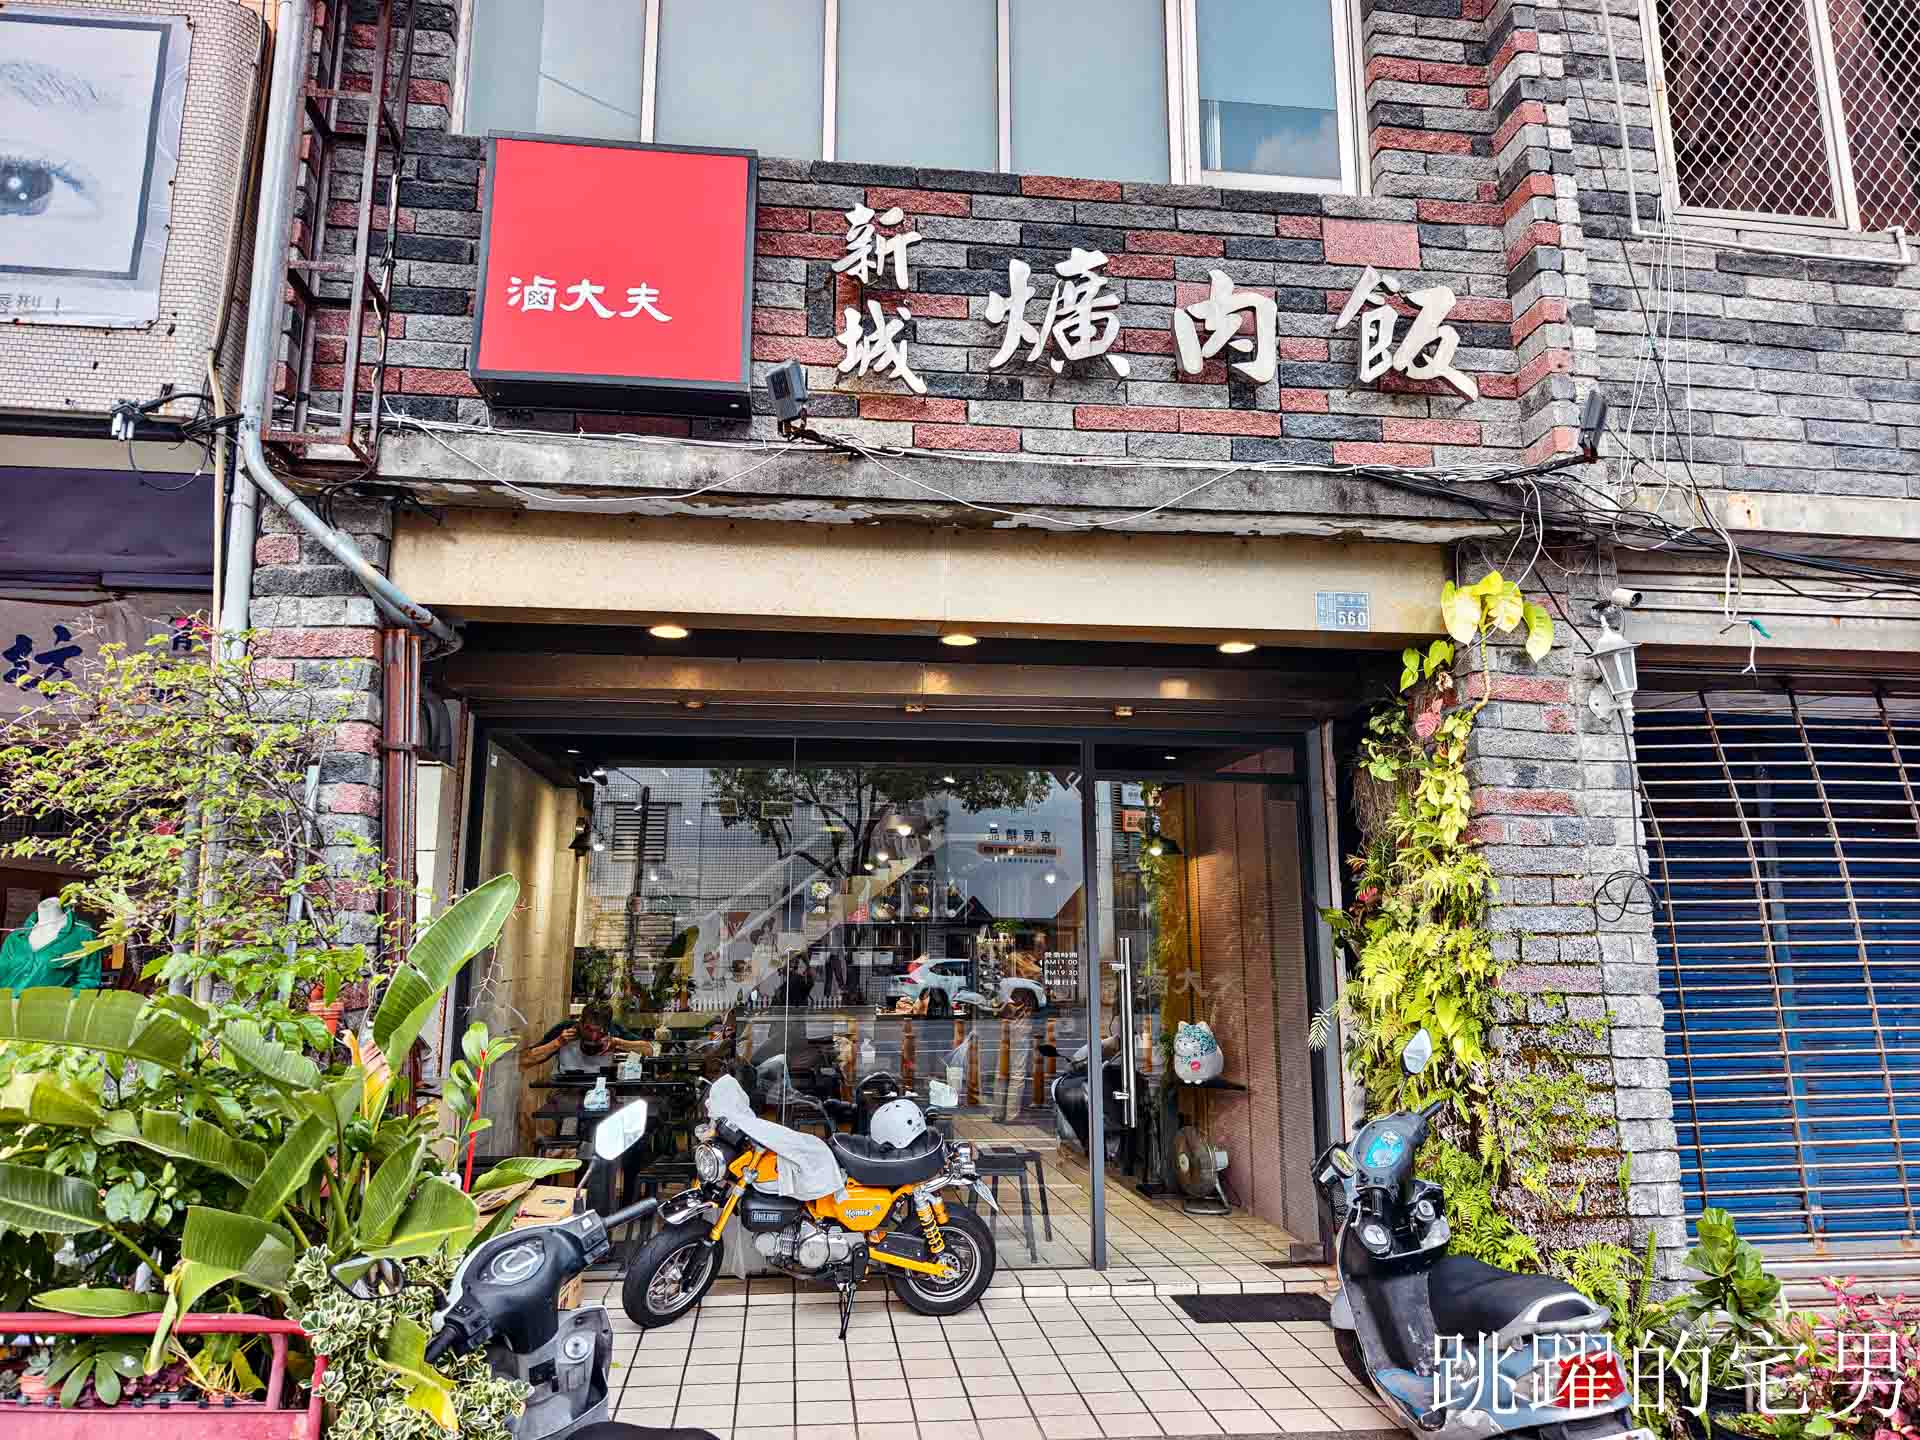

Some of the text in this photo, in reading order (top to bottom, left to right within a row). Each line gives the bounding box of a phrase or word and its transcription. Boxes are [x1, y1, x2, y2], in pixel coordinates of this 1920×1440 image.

[507, 275, 672, 322] 滷大夫
[832, 202, 928, 394] 新城
[984, 247, 1478, 401] 爌肉飯
[1338, 611, 1366, 625] 560
